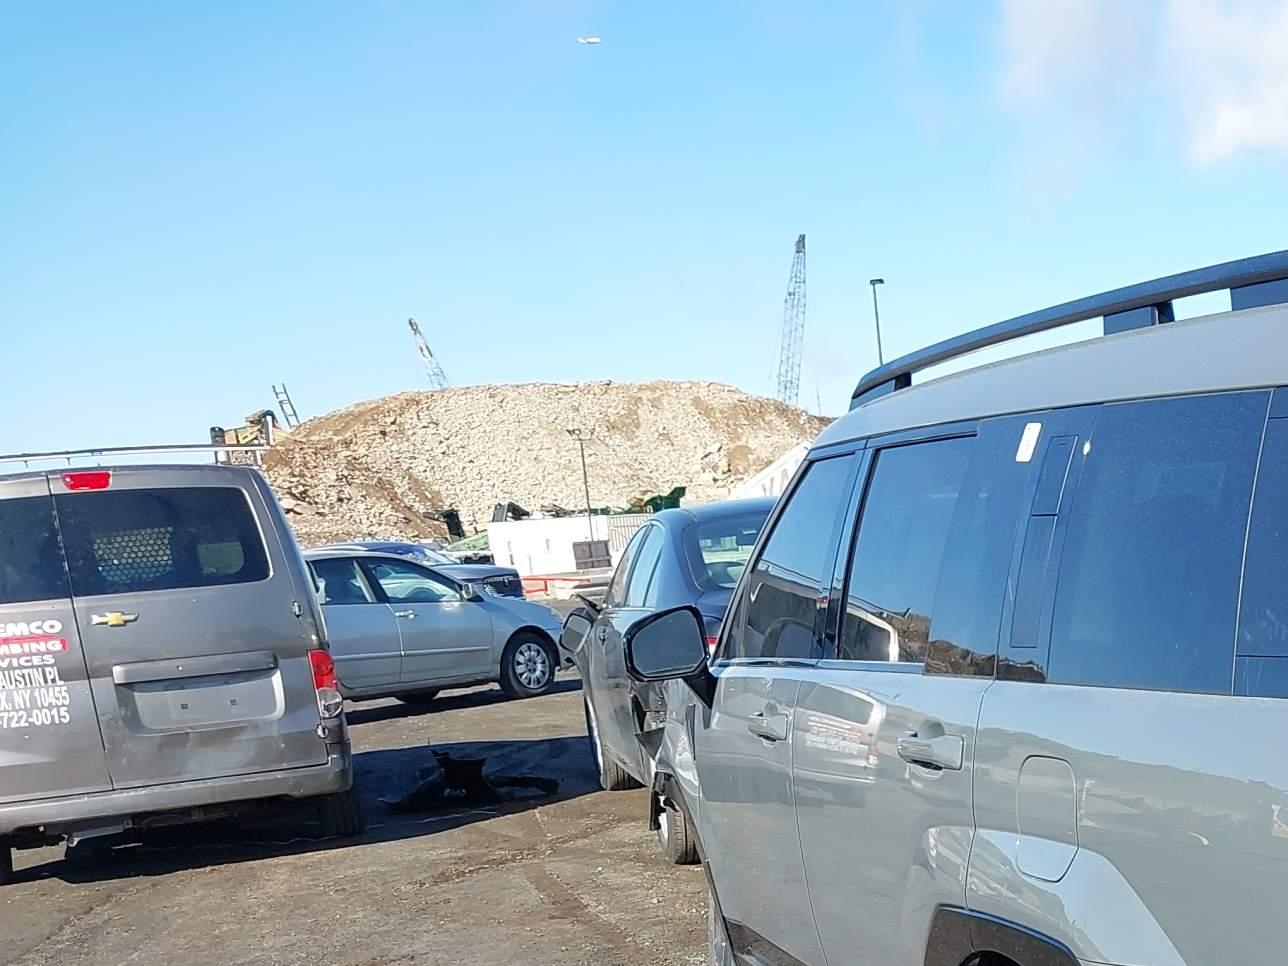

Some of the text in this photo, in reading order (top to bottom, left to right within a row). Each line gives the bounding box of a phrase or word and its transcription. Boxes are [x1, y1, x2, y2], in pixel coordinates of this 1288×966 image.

[47, 666, 65, 686] PL
[13, 689, 31, 709] NY
[34, 686, 70, 707] 10455
